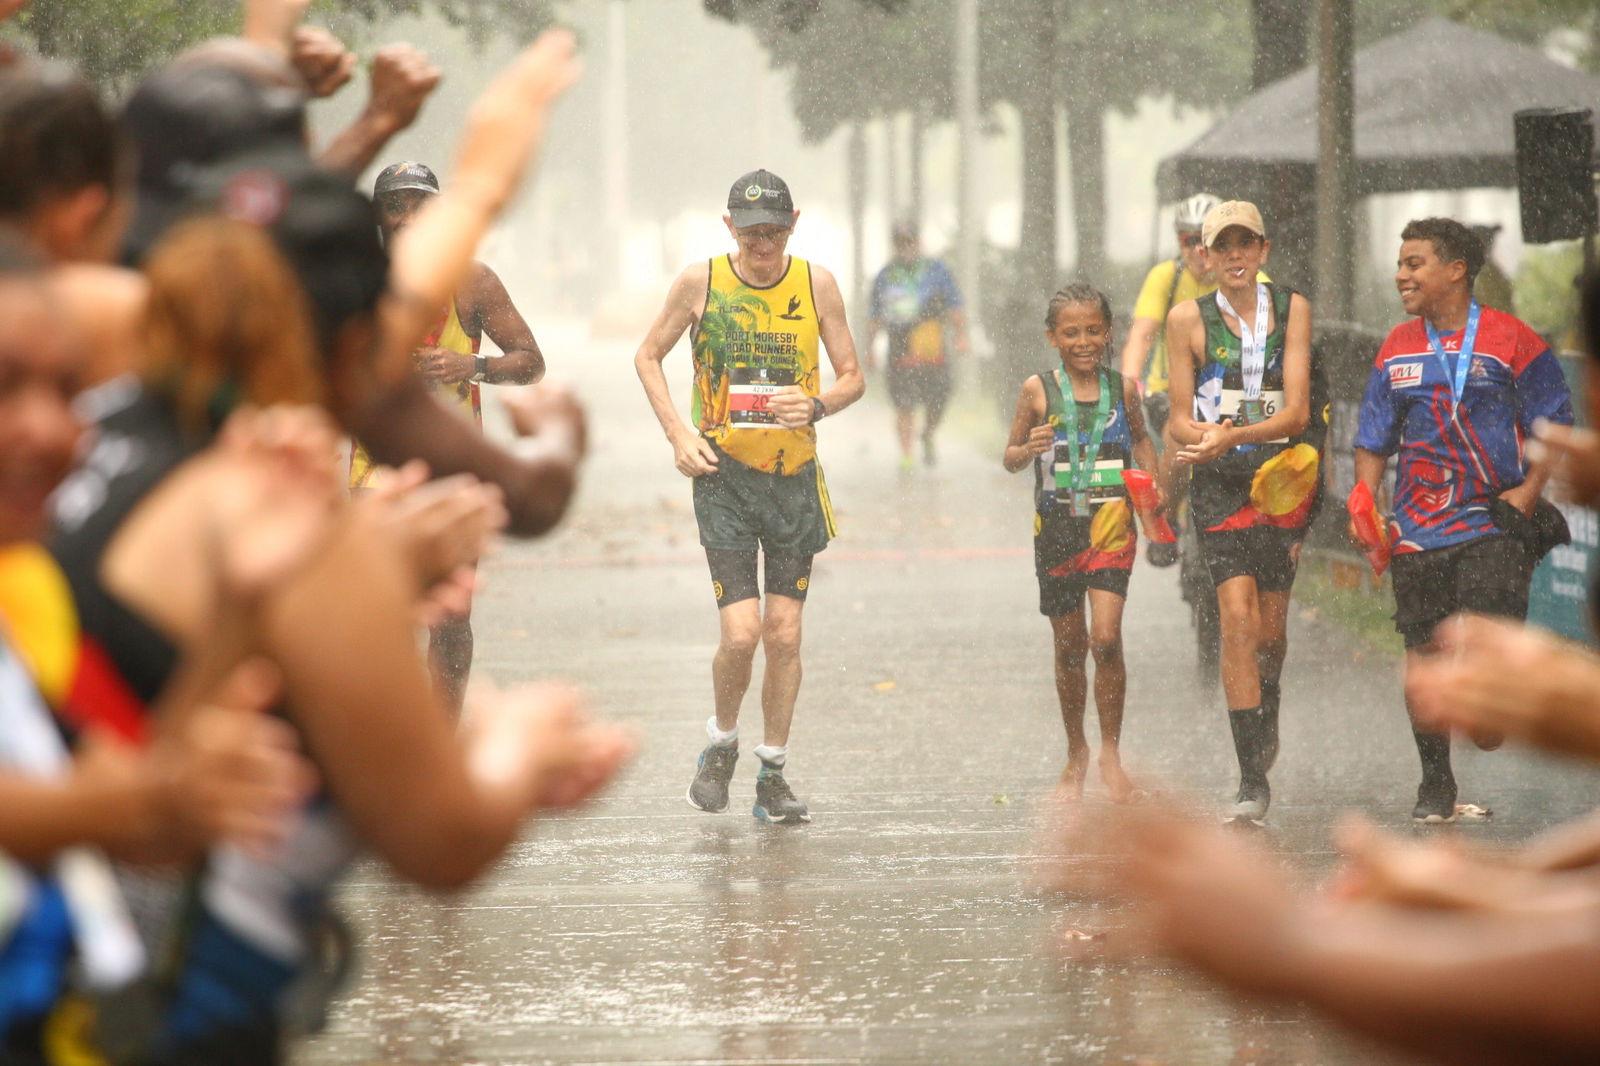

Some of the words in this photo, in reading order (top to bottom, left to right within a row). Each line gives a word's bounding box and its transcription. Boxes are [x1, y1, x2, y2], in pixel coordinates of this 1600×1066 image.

[725, 331, 750, 342] PORT
[754, 331, 798, 344] MORESBY
[726, 342, 752, 353] ROAD
[754, 343, 798, 355] RUNNERS
